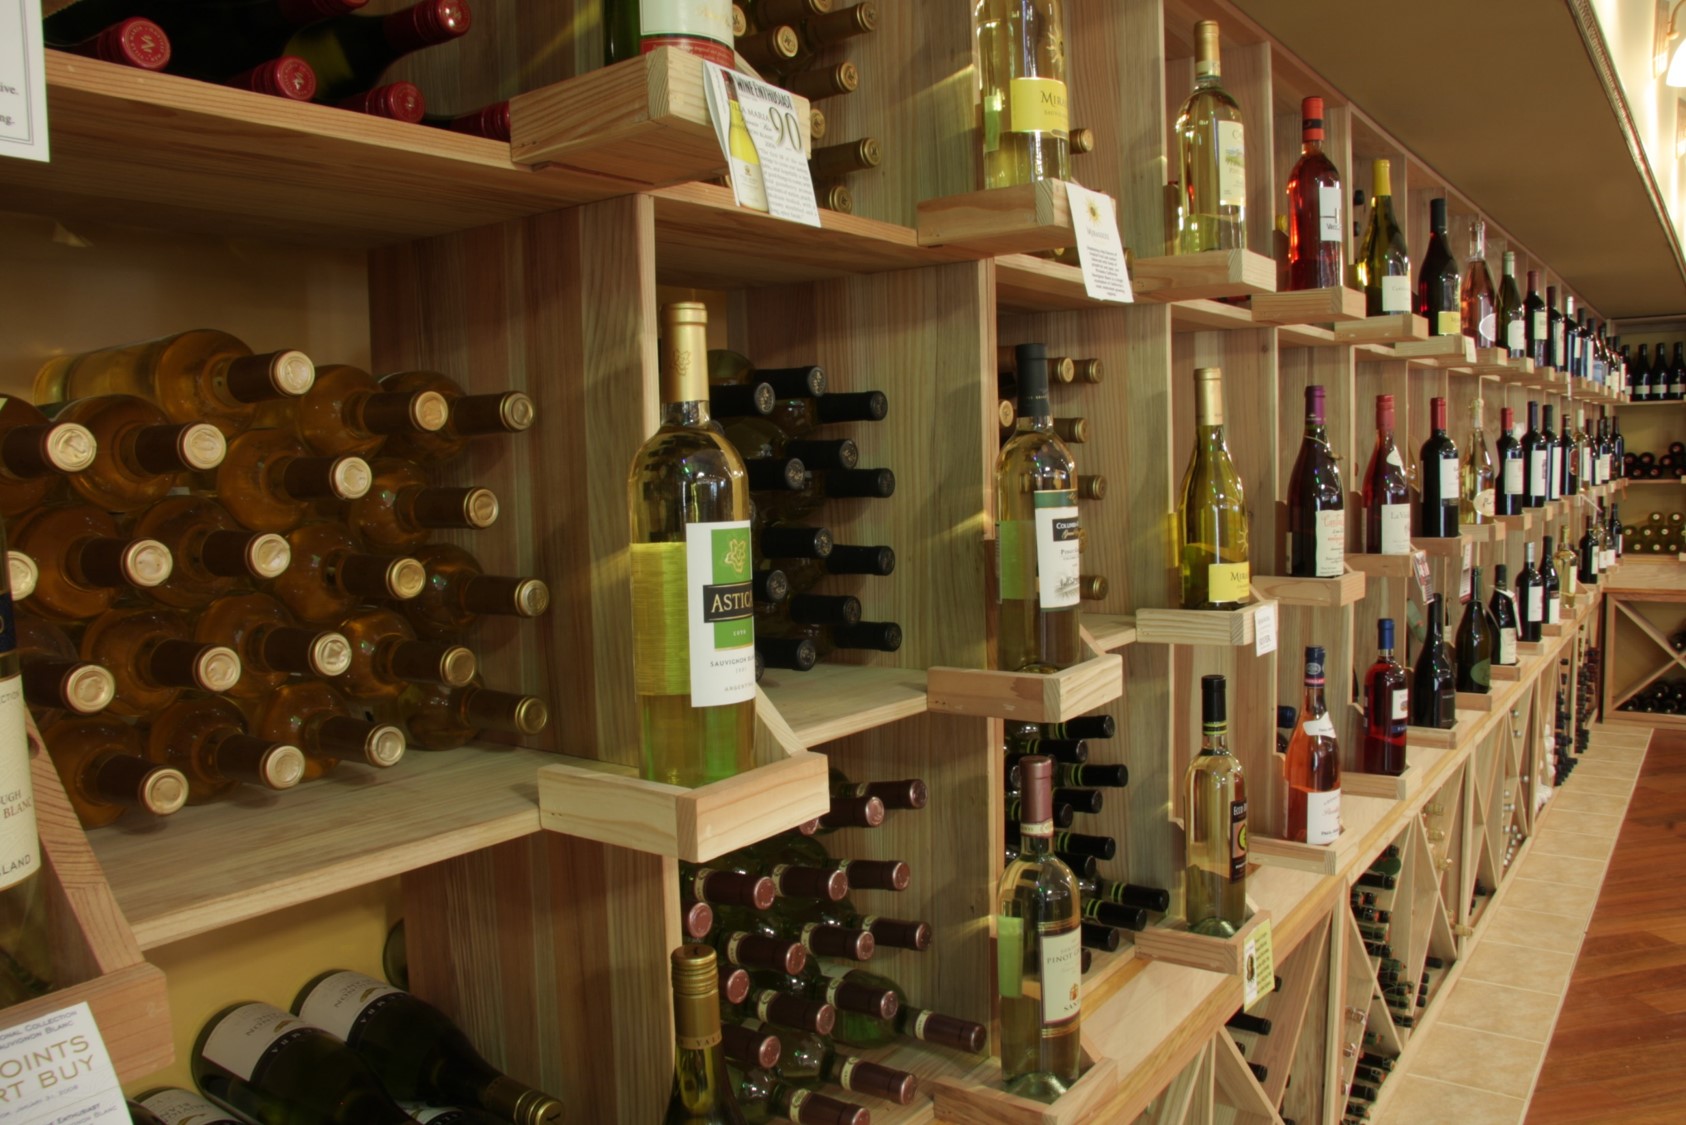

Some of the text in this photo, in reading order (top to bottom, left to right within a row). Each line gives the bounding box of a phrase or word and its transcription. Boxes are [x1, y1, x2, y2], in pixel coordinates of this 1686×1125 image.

[0, 83, 19, 96] ive.
[0, 114, 16, 127] ng.
[769, 106, 802, 151] 90
[0, 789, 22, 805] UGH
[0, 853, 31, 876] LAND
[1046, 952, 1073, 966] PINOT
[0, 1011, 77, 1041] ONAL COLLECTION
[0, 1019, 74, 1050] AUVIGNON BLANC
[0, 1035, 89, 1078] OINTS
[38, 1054, 94, 1088] BUY
